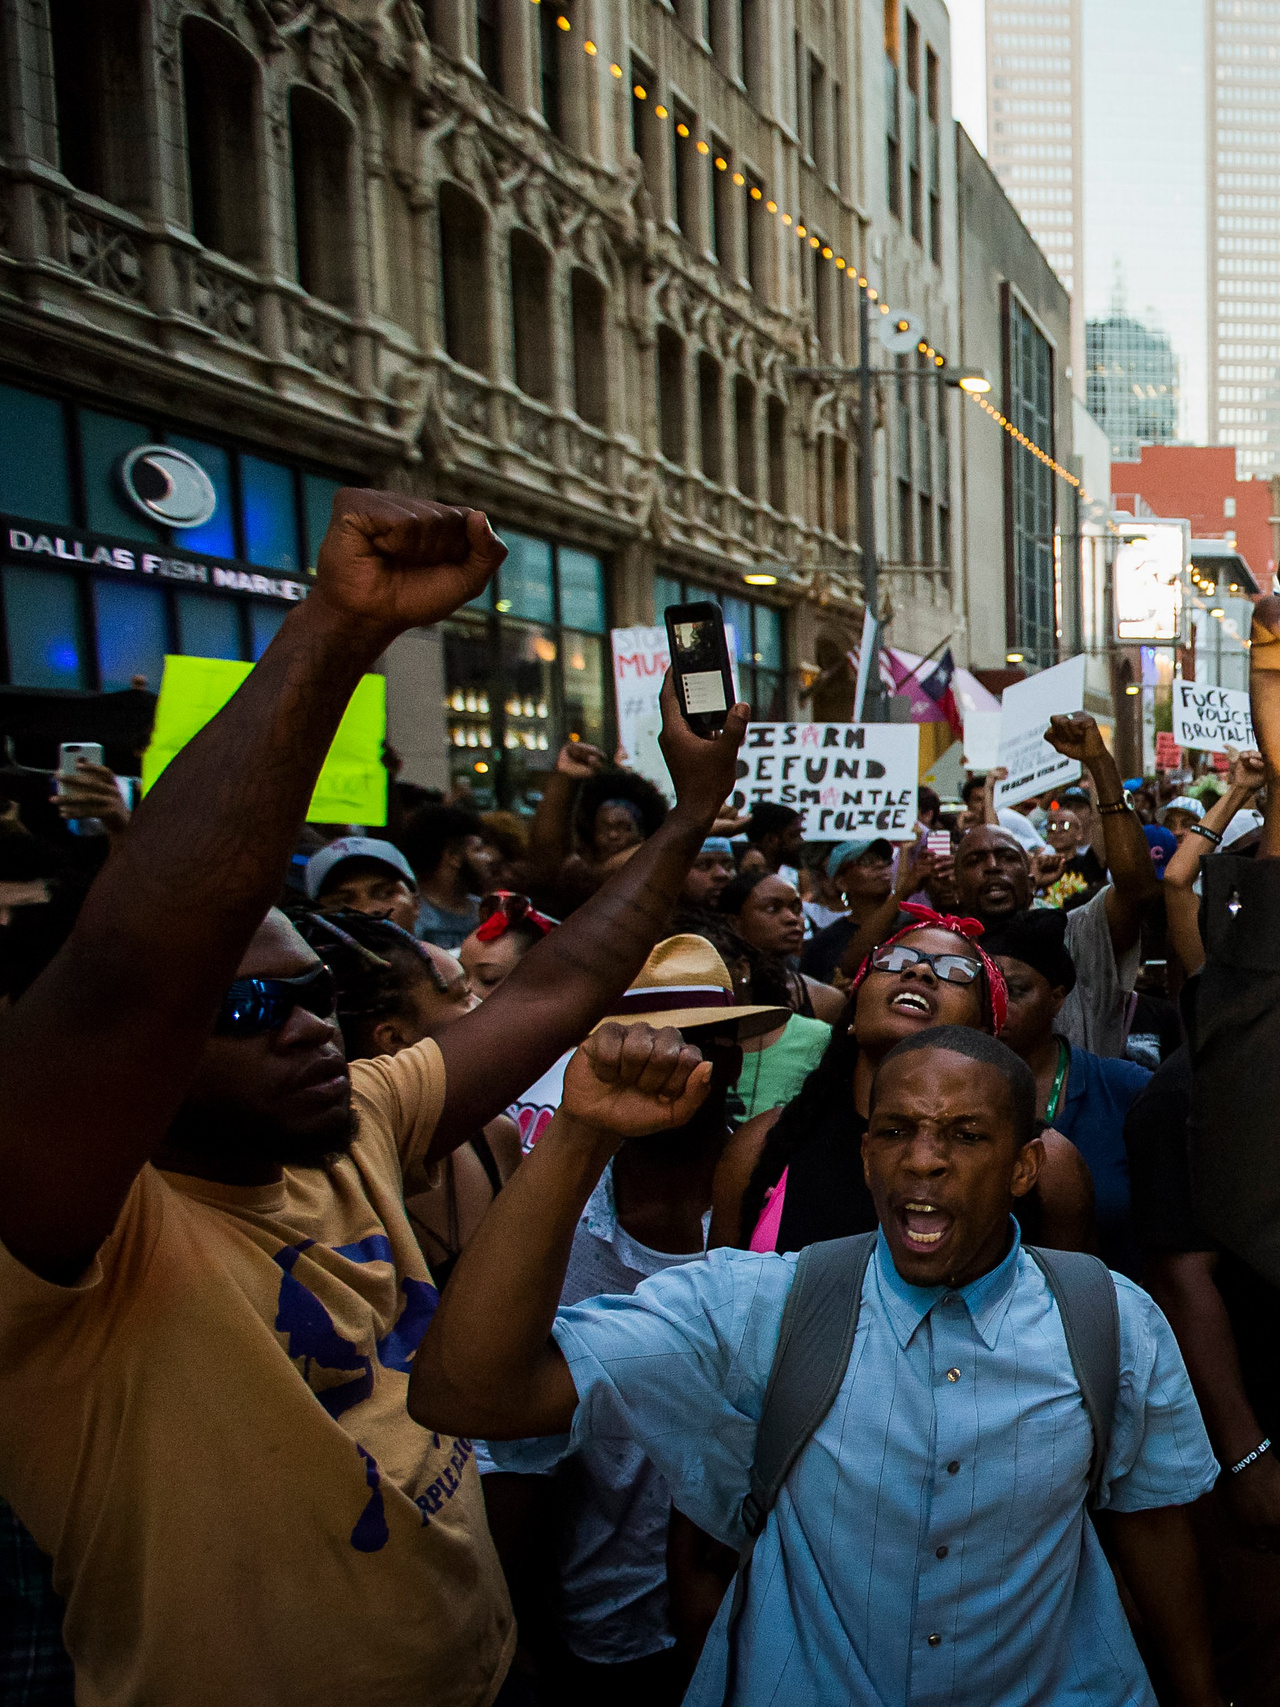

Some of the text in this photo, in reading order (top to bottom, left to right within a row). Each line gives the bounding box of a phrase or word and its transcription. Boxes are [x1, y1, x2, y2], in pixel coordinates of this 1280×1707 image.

[9, 529, 312, 601] DALLAS FISH MARKET
[1181, 686, 1230, 709] FUCK
[1197, 707, 1251, 725] POLICE
[740, 724, 865, 749] ISARM
[1182, 722, 1254, 744] BRUTALIT
[735, 756, 886, 784] DEFUND
[733, 785, 912, 811] DISMANTLE
[819, 809, 906, 832] POLICE
